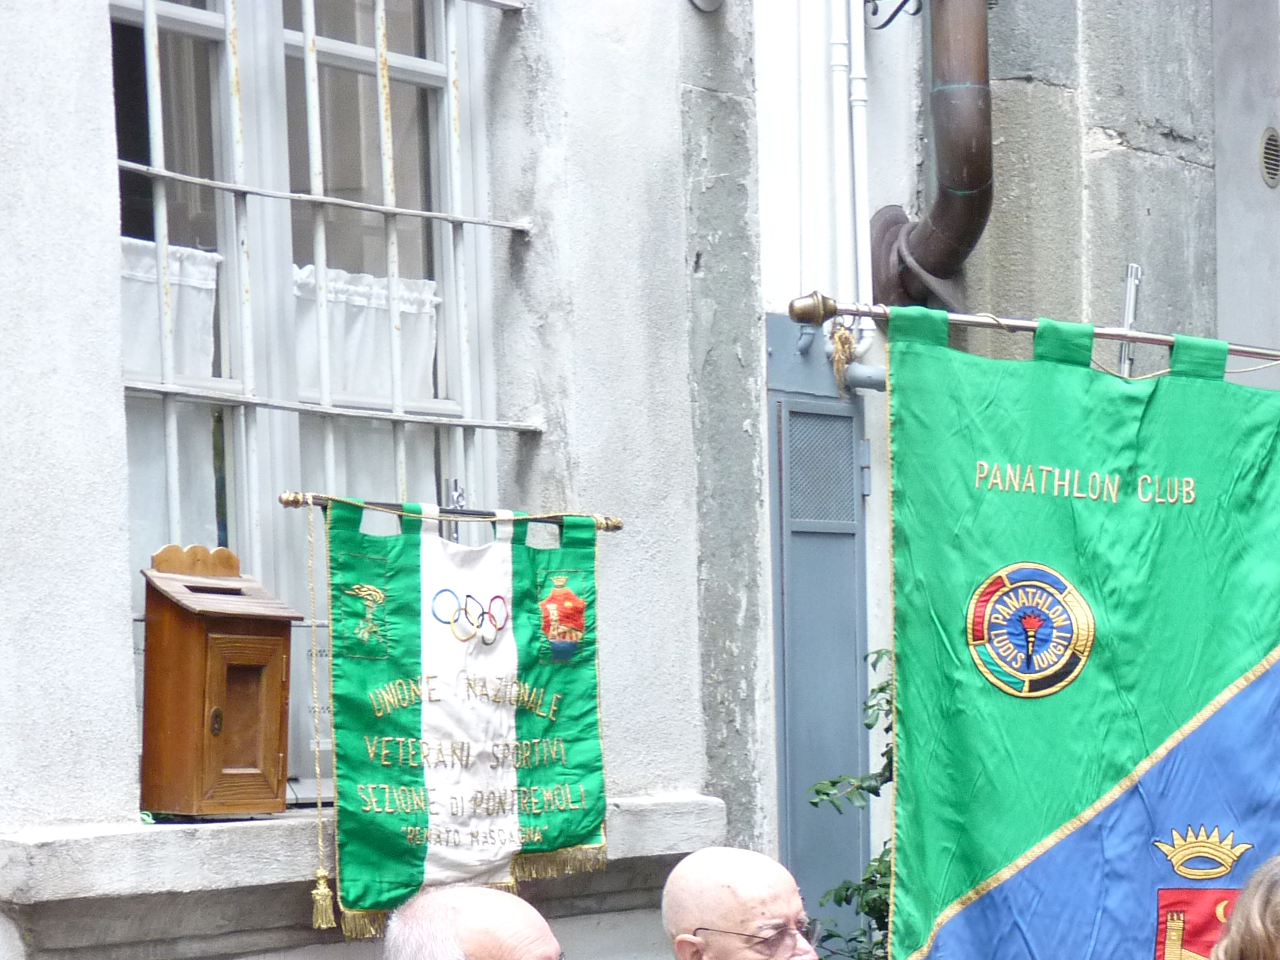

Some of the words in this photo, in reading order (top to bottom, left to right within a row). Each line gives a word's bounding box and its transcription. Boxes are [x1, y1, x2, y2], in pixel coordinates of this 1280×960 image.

[975, 461, 1120, 503] PANATHLON
[1137, 474, 1196, 504] CLUB
[991, 588, 1071, 628] PANATHLON
[990, 629, 1026, 669] LUDIS
[1033, 629, 1072, 670] IUNGIT
[369, 675, 441, 718] UNIONE
[466, 675, 562, 721] NAZIONALE
[364, 735, 471, 768] VETERANI
[490, 738, 567, 769] SPORTIVI
[357, 783, 440, 816] SEZIONE
[449, 797, 465, 817] DI
[472, 783, 587, 816] PONTREMOLI
